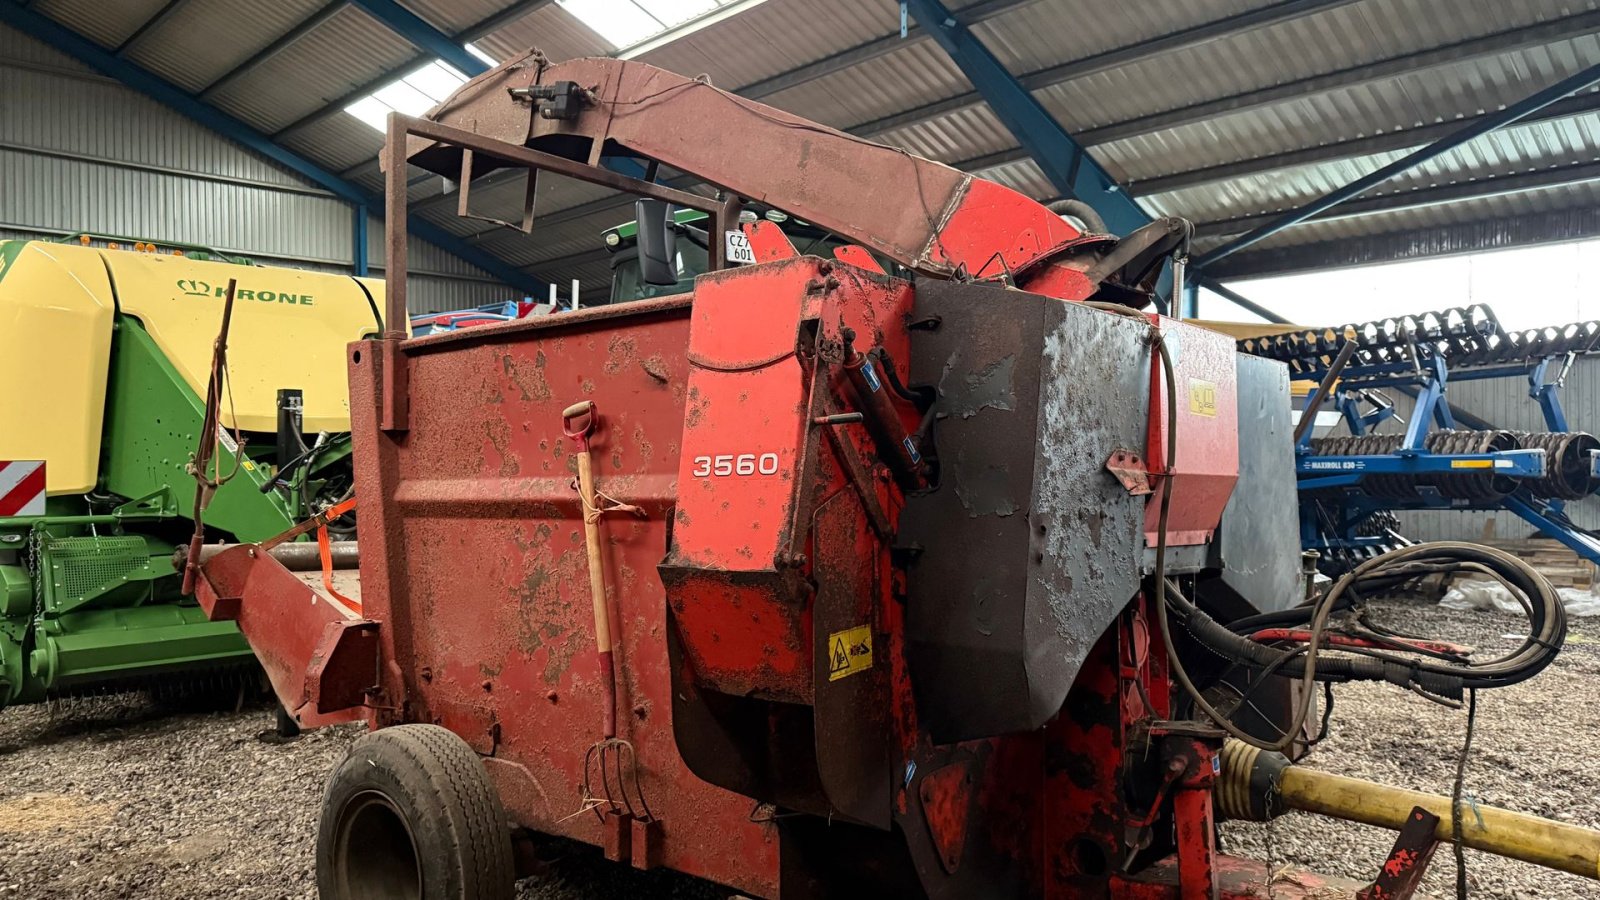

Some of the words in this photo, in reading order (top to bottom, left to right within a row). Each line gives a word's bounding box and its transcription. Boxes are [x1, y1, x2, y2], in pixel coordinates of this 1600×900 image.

[734, 248, 752, 261] 601
[214, 287, 314, 306] KRONE
[693, 452, 779, 477] 3560
